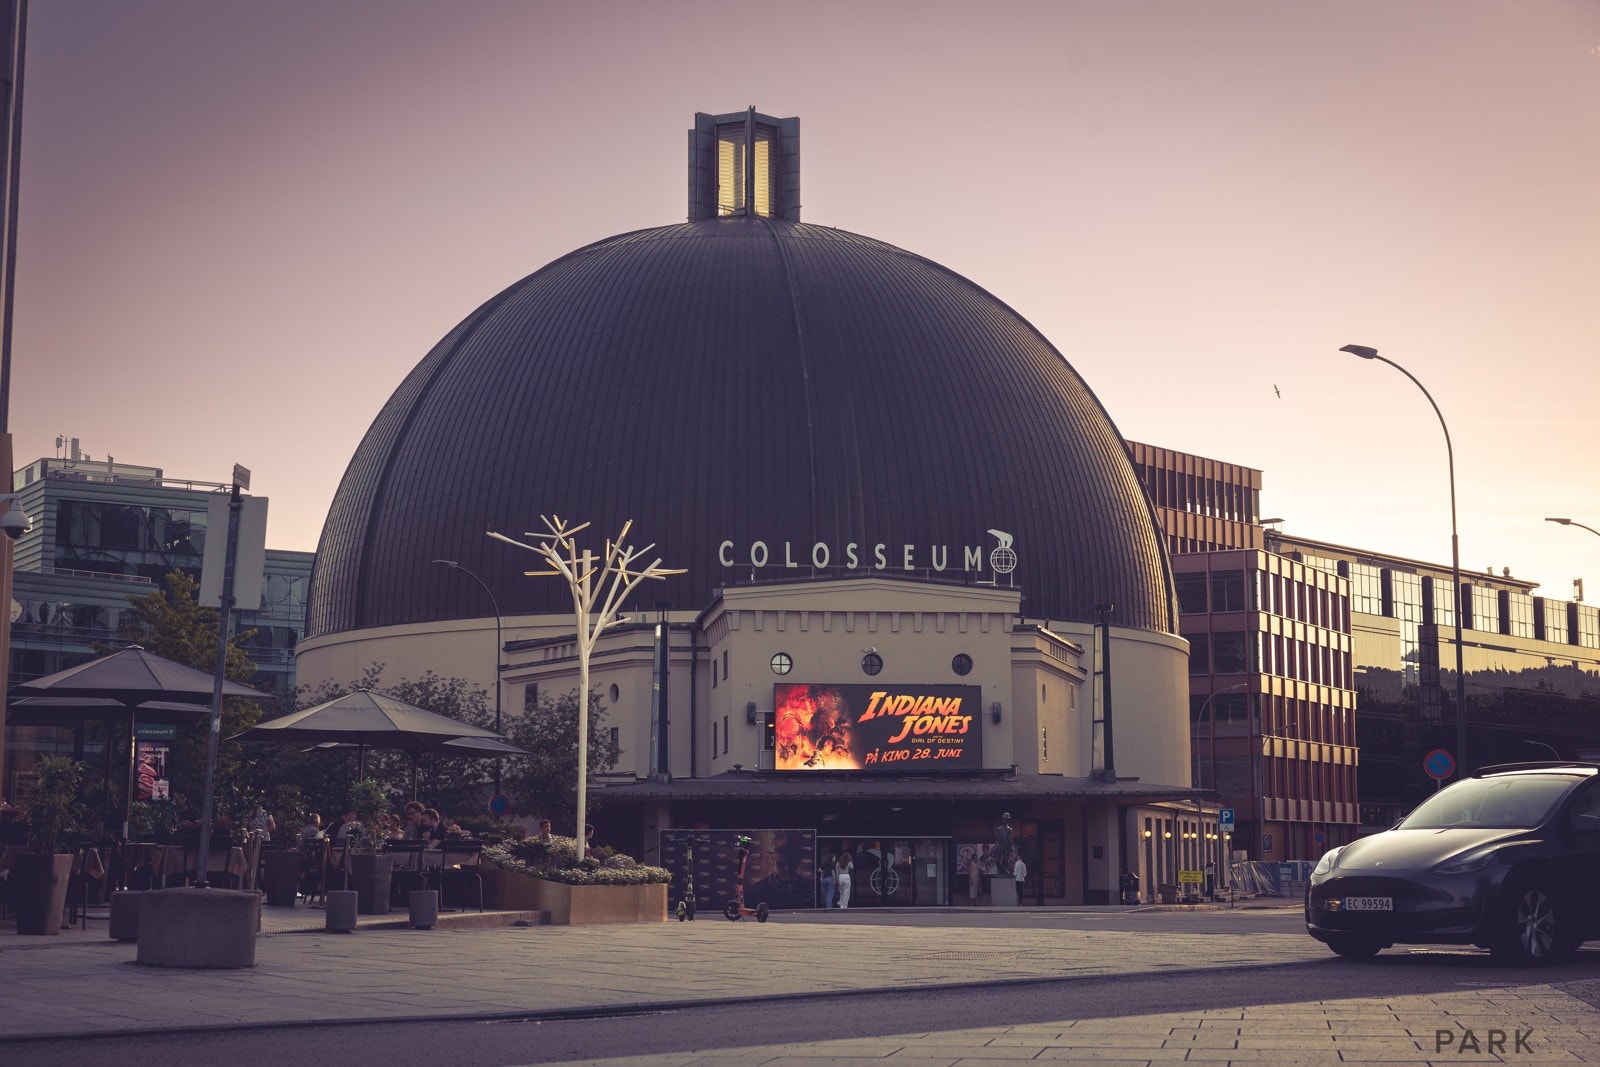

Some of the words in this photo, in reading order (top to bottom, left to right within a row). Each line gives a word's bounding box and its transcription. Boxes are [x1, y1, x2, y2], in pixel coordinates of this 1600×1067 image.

[719, 540, 982, 572] COLOSSEUM
[857, 691, 963, 723] INDIANA
[887, 715, 973, 744] JONES
[864, 747, 879, 765] PÅ
[881, 749, 911, 763] KINO
[912, 748, 931, 760] 28.
[933, 748, 963, 759] JUNI
[1222, 810, 1231, 823] P
[1347, 898, 1358, 909] EC
[1361, 898, 1390, 909] 99594
